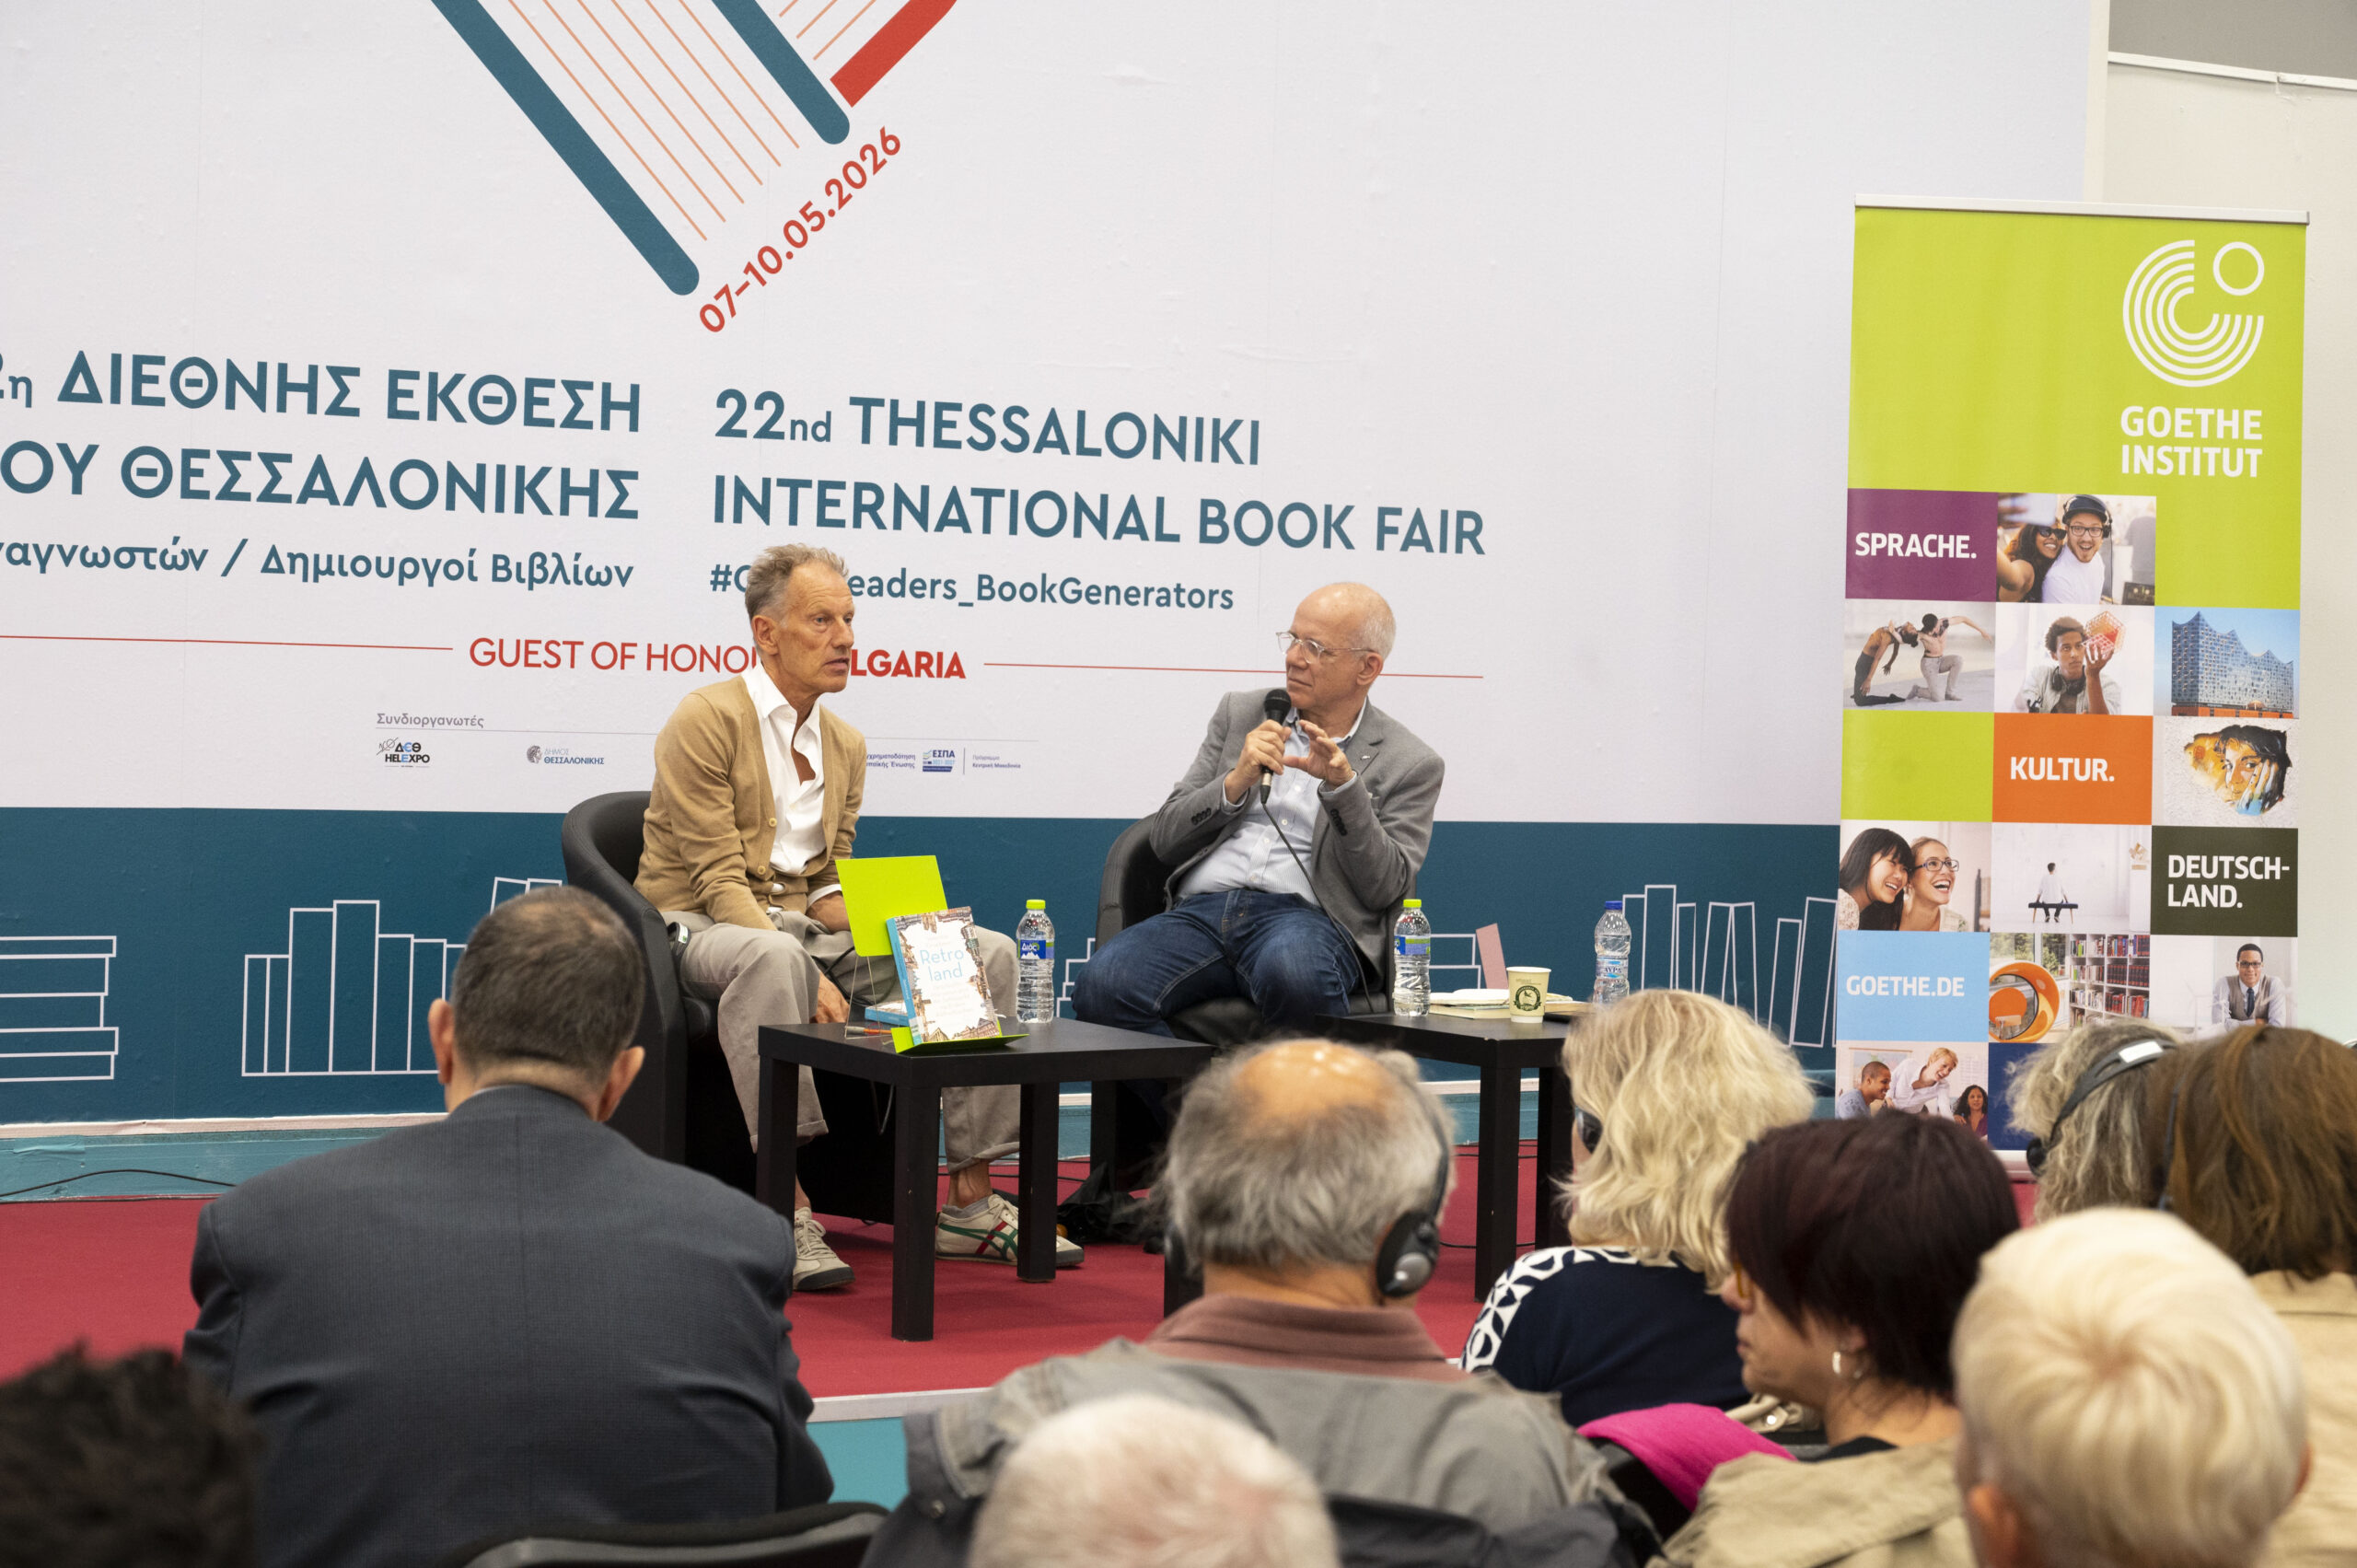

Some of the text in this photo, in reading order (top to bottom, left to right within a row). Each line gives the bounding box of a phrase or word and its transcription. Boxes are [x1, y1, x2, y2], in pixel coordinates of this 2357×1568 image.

[0, 350, 640, 433] η ΔΙΕΘΝΗΣ ΕΚΘΕΣΗ
[714, 388, 1260, 466] 22nd THESSALONIKI
[2120, 405, 2263, 440] GOETHE
[2121, 445, 2263, 478] INSTITUT
[121, 446, 639, 519] ΘΕΣΣΑΛΟΝΙΚΗΣ
[714, 474, 1485, 555] INTERNATIONAL BOOK FAIR
[1854, 532, 1977, 559] SPRACHE.
[260, 544, 478, 587] Δημιουργοί
[491, 552, 633, 591] Βιβλίων
[470, 637, 584, 669] GUEST
[592, 641, 637, 670] OF
[850, 648, 966, 679] LGARIA
[377, 713, 484, 728] Συνδιοργανωτές
[385, 753, 430, 763] HELEXPO
[544, 756, 605, 765] ΘΕΣΣΑΛΟΝΙΚΗΣ
[932, 749, 956, 758] ΕΣΠΑ
[2010, 756, 2115, 782] KULTUR.
[2167, 854, 2291, 880] DEUTSCH-
[2167, 883, 2244, 909] LAND.
[919, 947, 964, 965] Retro
[928, 961, 963, 981] land
[1846, 975, 1965, 997] GOETHE.DE
